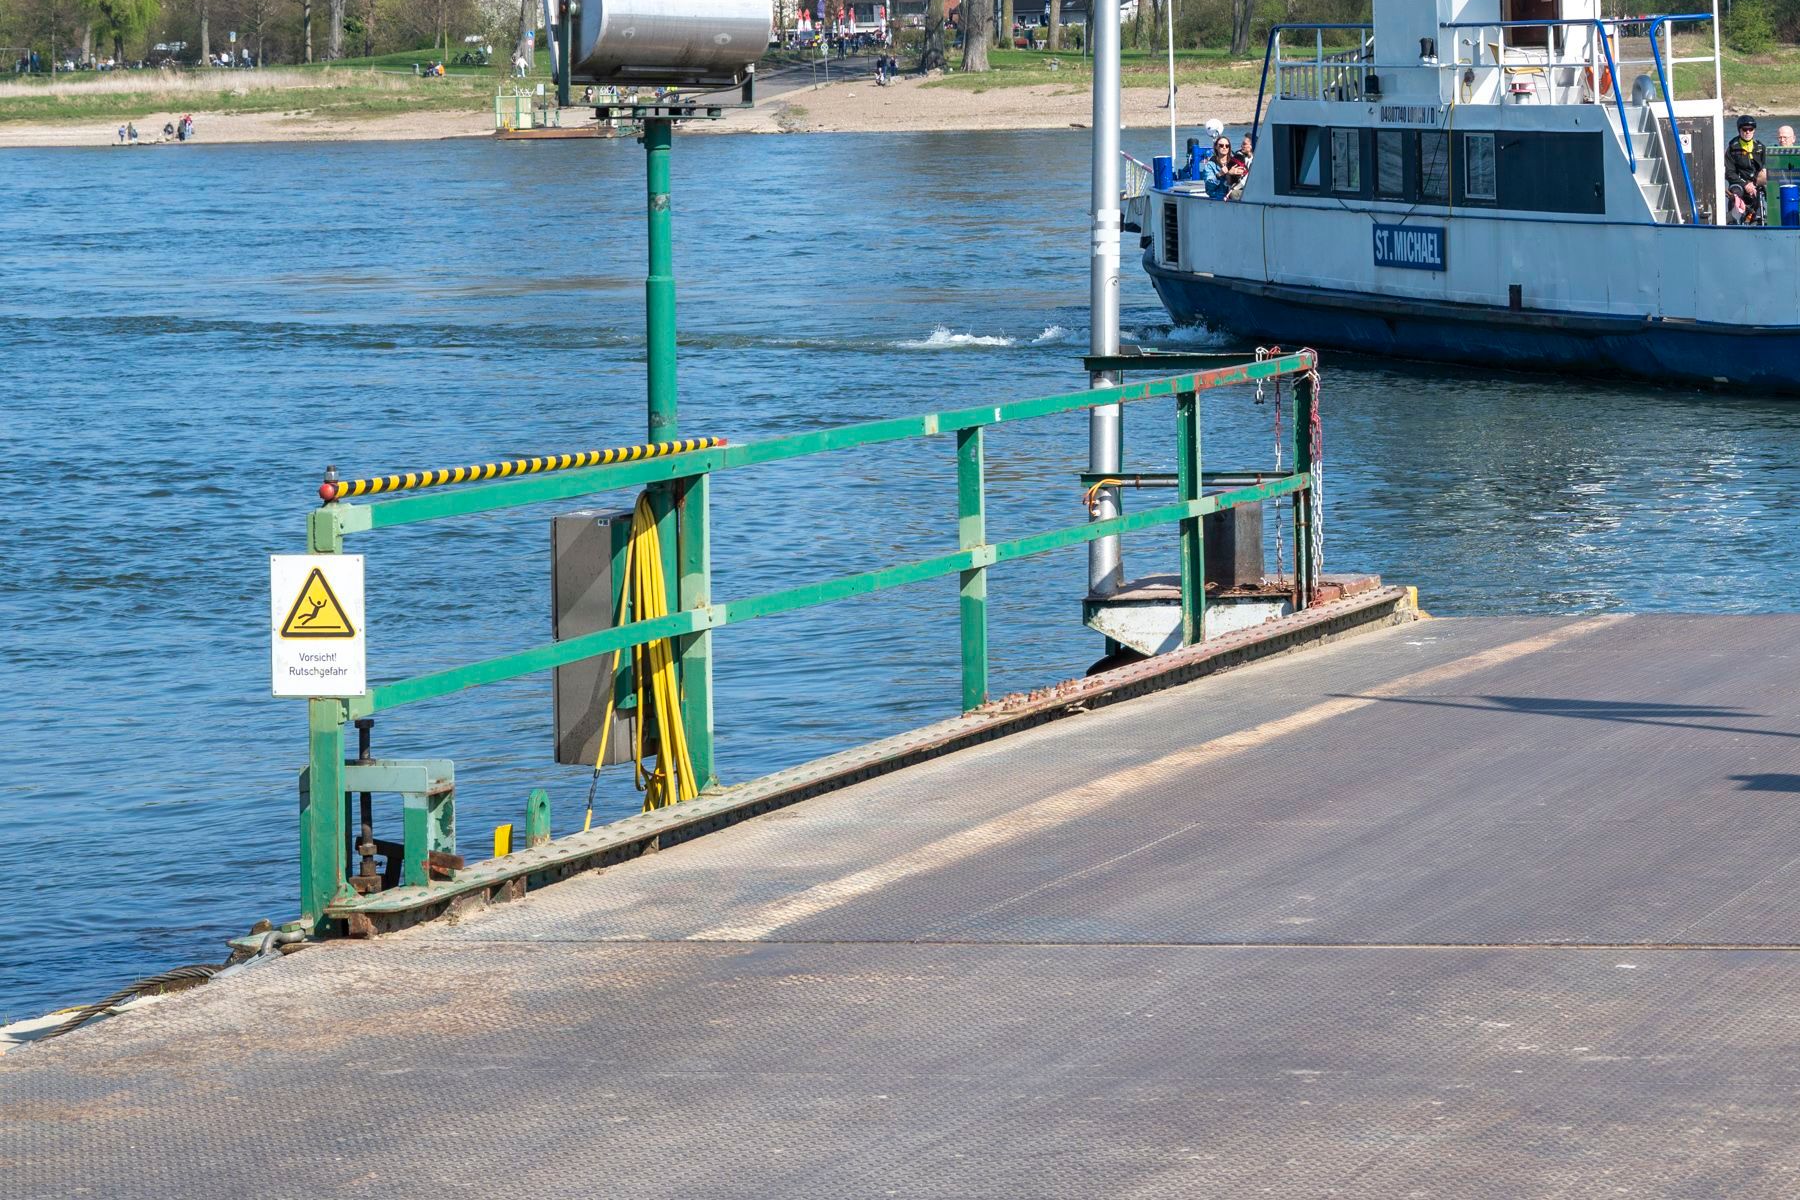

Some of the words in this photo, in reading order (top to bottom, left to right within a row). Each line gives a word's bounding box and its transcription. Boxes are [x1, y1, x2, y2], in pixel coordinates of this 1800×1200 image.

[1375, 229, 1393, 260] ST.
[1393, 230, 1441, 264] MICHAEL
[298, 652, 337, 662] Vorsicht!
[288, 667, 348, 678] Rutschgefahr
